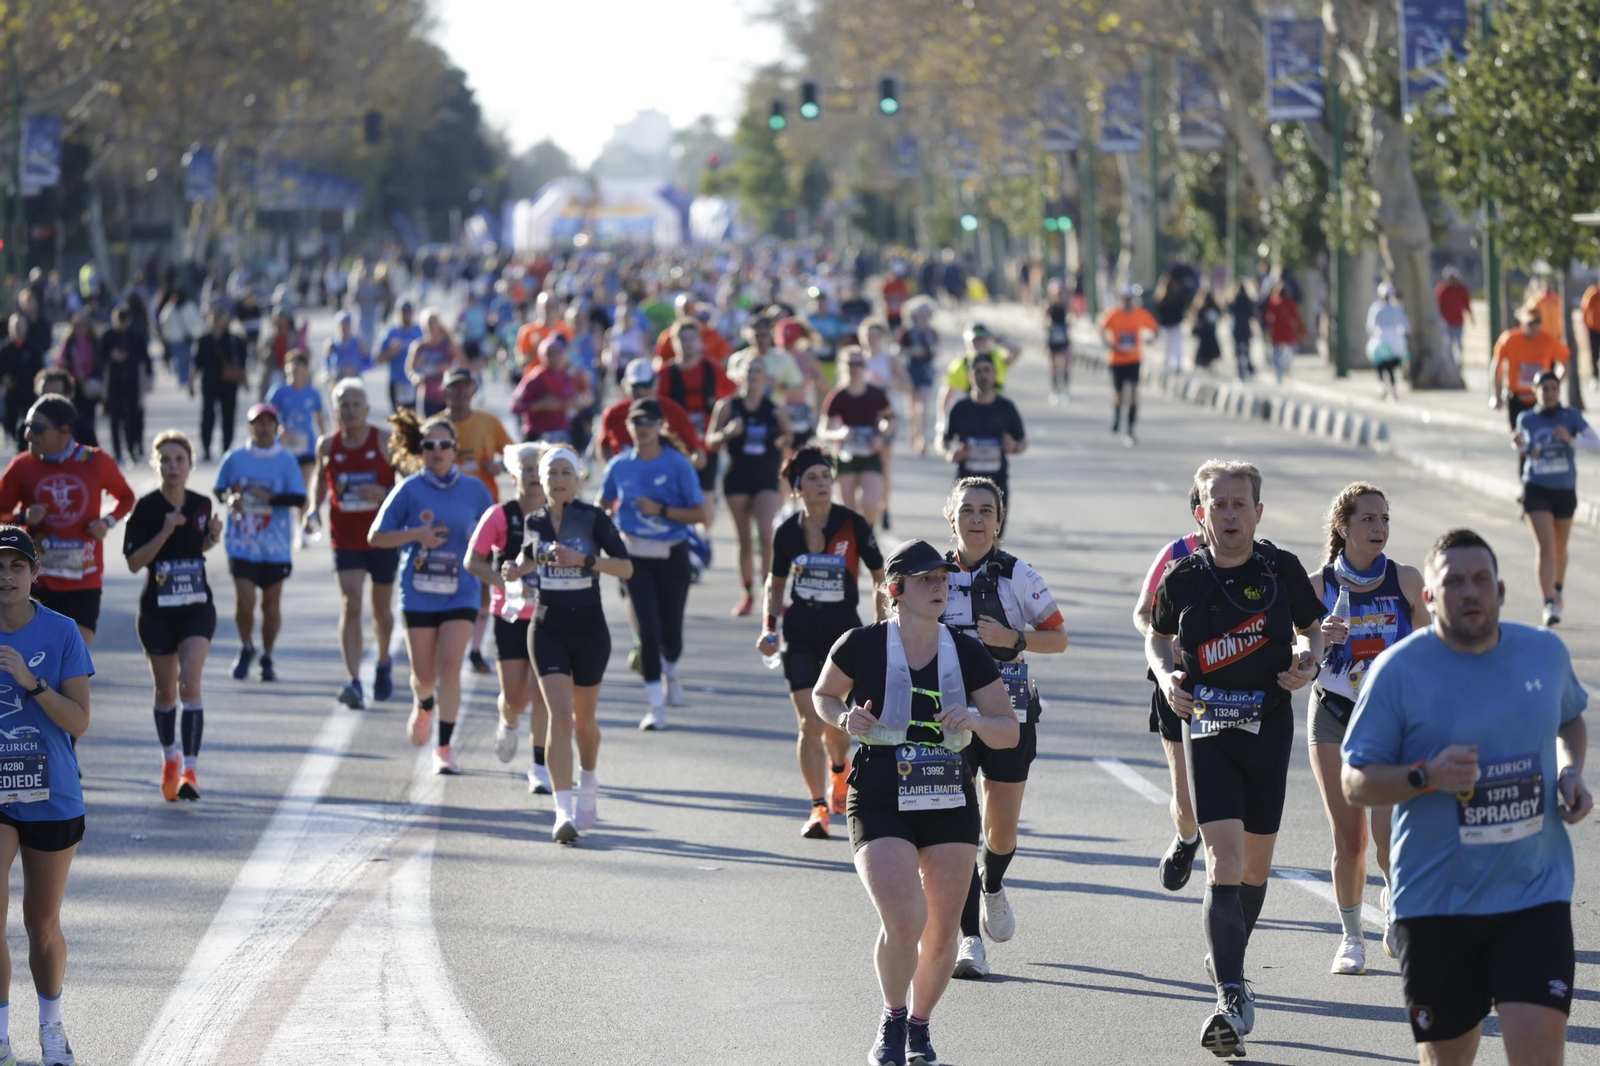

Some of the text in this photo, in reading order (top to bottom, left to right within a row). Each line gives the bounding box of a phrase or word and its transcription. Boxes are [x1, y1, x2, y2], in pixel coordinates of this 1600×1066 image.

[810, 557, 839, 565] ZURICH
[548, 567, 583, 577] LOUISE
[172, 584, 193, 594] LAIA
[795, 578, 844, 590] LAURENCE
[1205, 616, 1267, 667] MONTOIS
[1218, 692, 1256, 702] ZURICH
[1214, 708, 1239, 718] 13246
[922, 766, 945, 776] 13992
[1487, 759, 1532, 778] ZURICH
[1487, 786, 1519, 802] 13713
[1464, 798, 1540, 825] SPRAGGY
